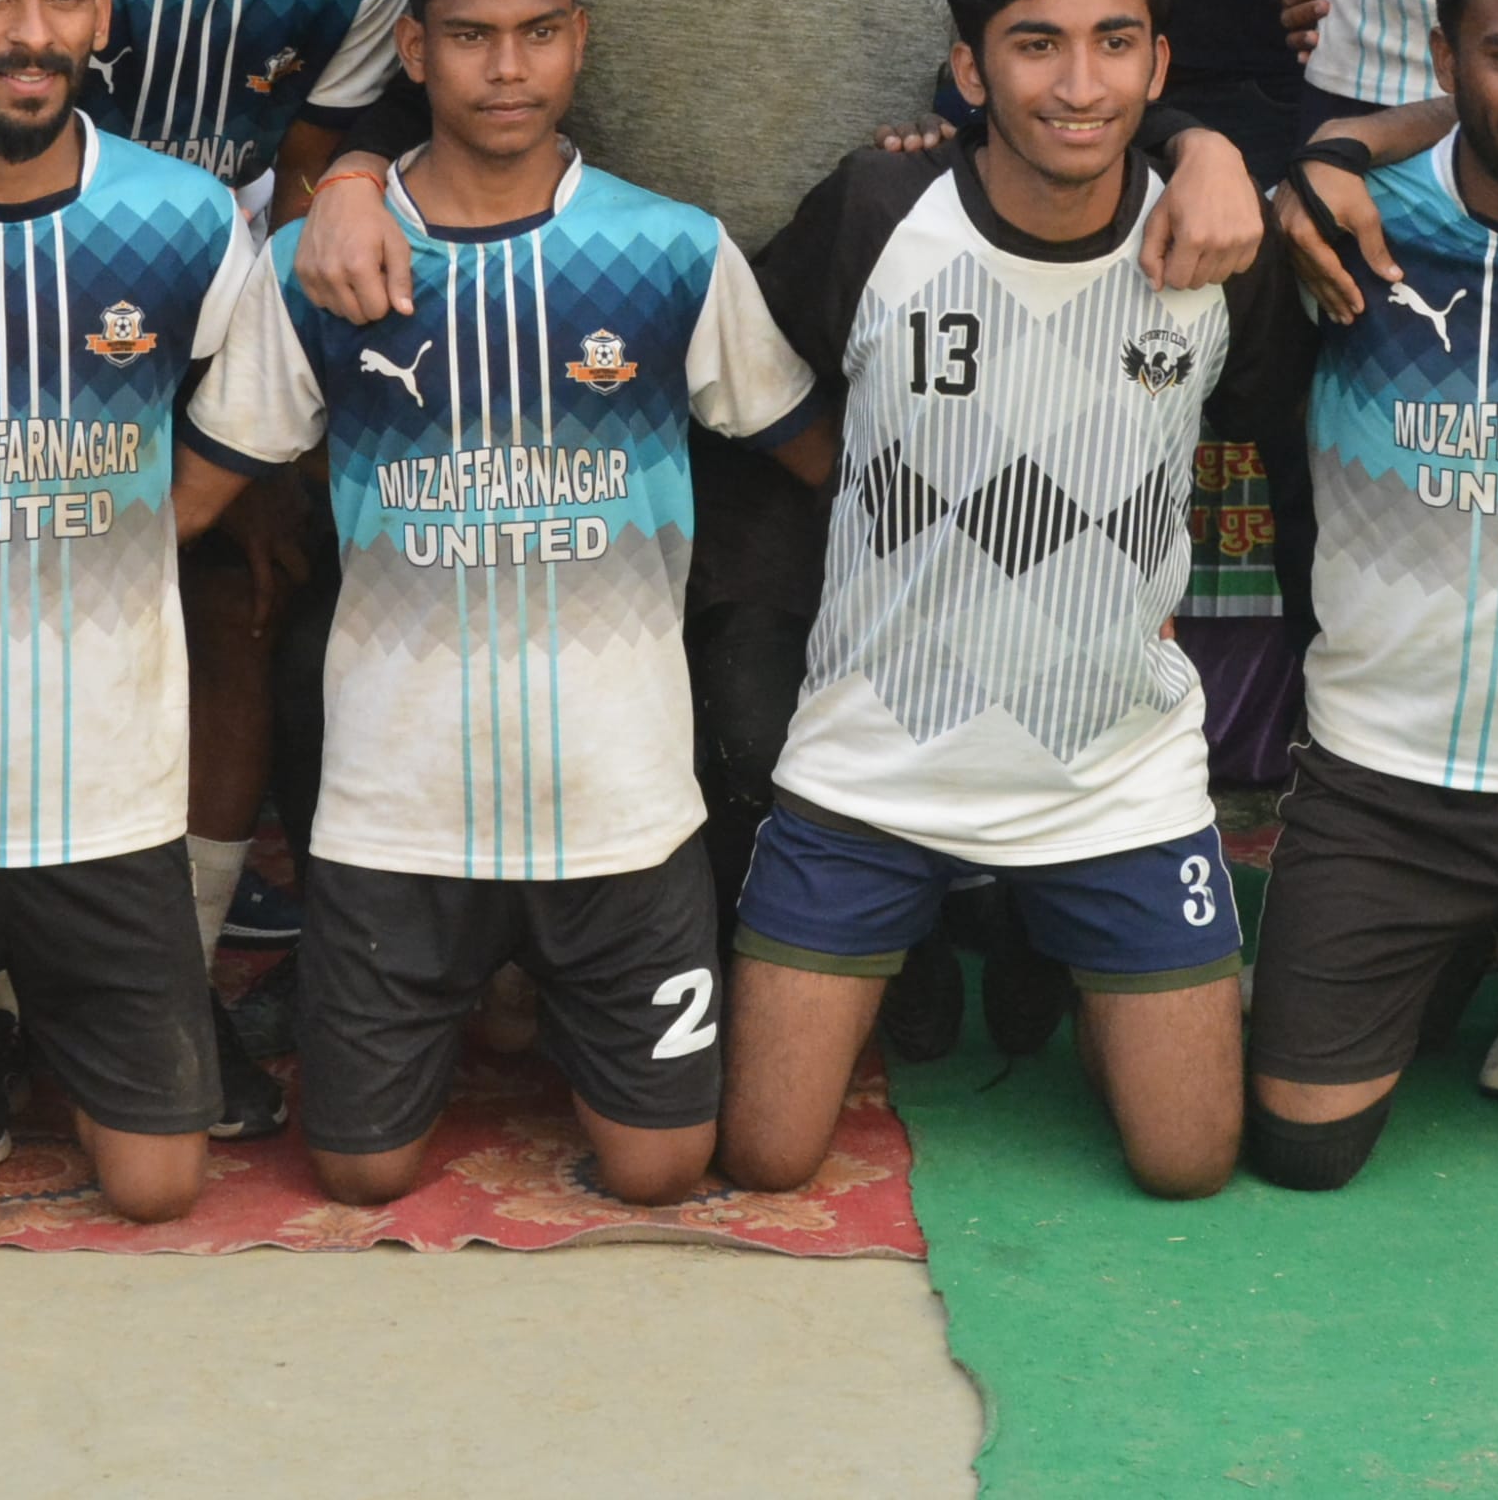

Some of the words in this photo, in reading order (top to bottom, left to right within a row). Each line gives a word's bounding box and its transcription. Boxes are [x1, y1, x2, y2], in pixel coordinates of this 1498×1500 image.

[909, 310, 981, 398] 13
[375, 443, 629, 512] MUZAFFARNAGAR
[402, 515, 610, 570] UNITED
[1178, 854, 1218, 928] 3
[650, 967, 718, 1061] 2
